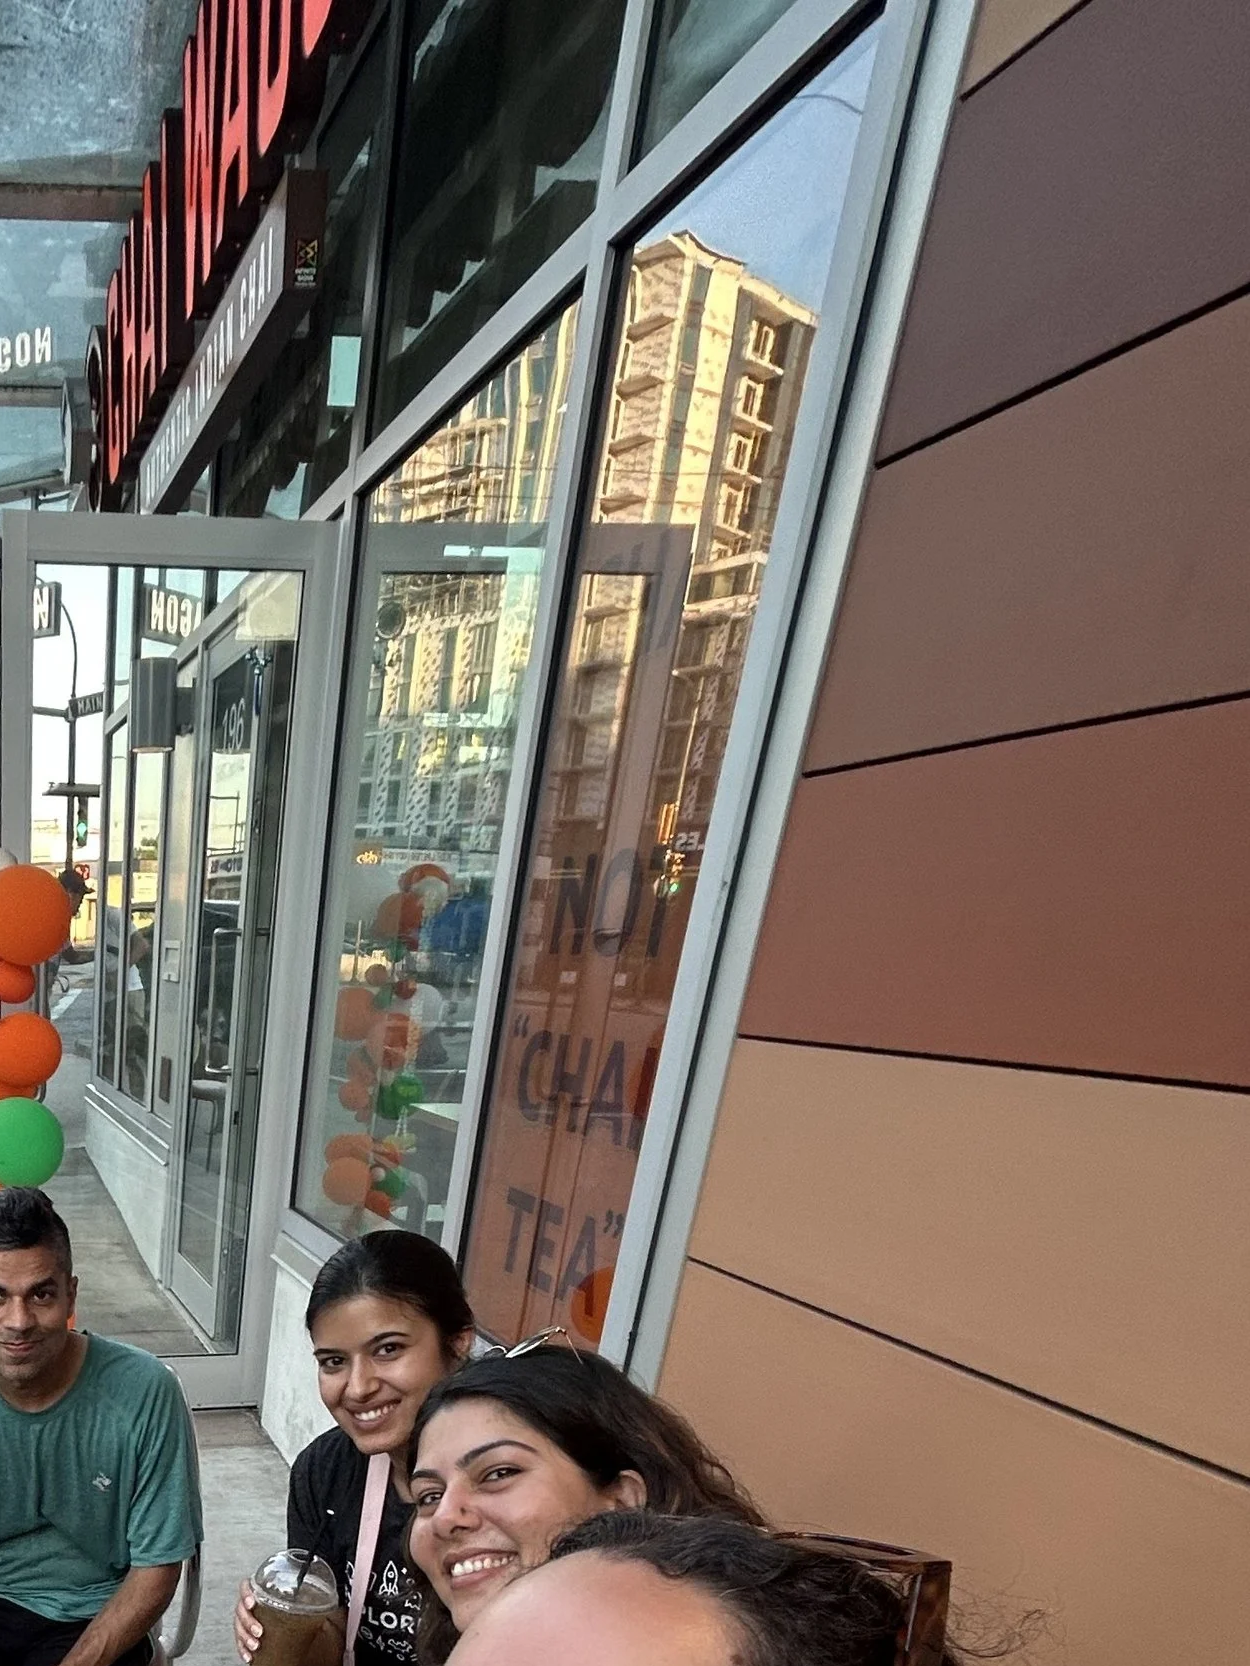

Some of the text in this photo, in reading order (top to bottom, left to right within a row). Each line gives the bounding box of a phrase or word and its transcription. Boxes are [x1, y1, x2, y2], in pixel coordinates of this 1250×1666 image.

[106, 116, 167, 485] CHAI
[146, 226, 273, 508] AUTHENTIC INDIAN CHAI
[222, 698, 246, 754] 196
[362, 1605, 422, 1635] LOR
